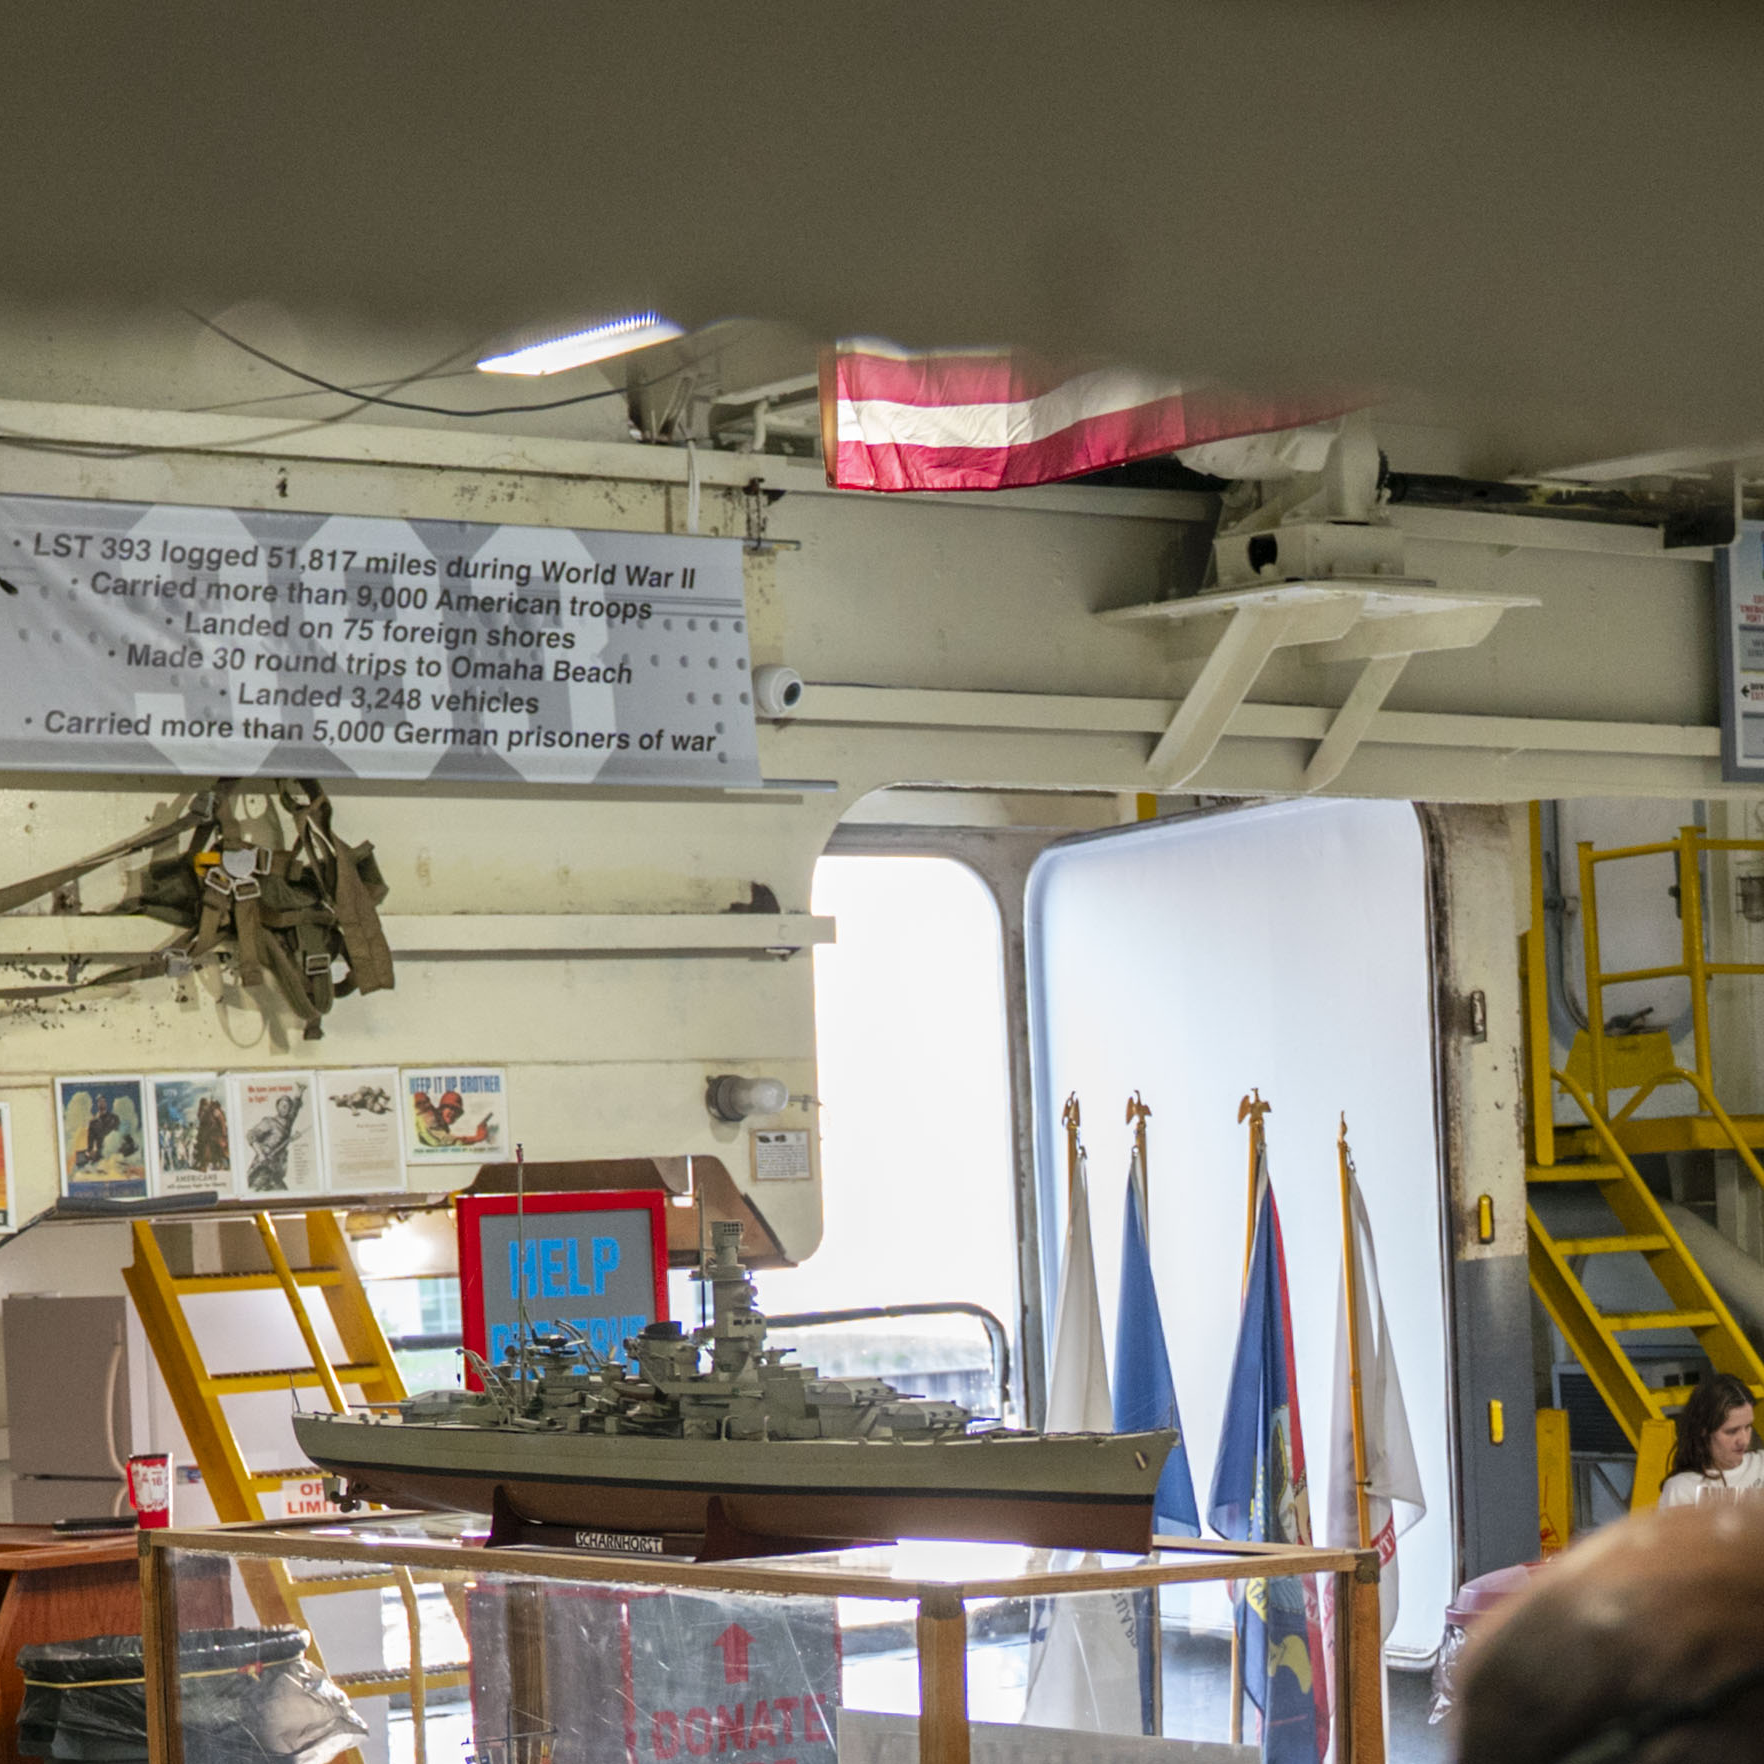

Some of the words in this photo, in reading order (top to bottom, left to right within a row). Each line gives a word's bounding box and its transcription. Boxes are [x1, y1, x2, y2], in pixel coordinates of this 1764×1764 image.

[34, 532, 93, 559] LST
[101, 537, 151, 562] 393
[161, 540, 258, 571] logged
[267, 547, 357, 575] 51,817
[365, 553, 436, 576] miles
[446, 556, 531, 587] during
[541, 560, 616, 586] World
[625, 565, 673, 588] War
[681, 567, 695, 589] II
[91, 571, 196, 599] Carried
[201, 581, 278, 602] more
[287, 581, 347, 606] than
[357, 585, 427, 612] 9,000
[436, 589, 560, 616] American
[570, 598, 652, 623] troops
[185, 611, 290, 638] Landed
[299, 620, 332, 640] on
[343, 618, 373, 641] 75
[383, 620, 477, 650] foreign
[486, 625, 576, 649] shores
[126, 643, 204, 669] Made
[212, 648, 245, 671] 30
[255, 651, 336, 674] round
[346, 653, 406, 680] trips
[416, 656, 441, 677] to
[450, 657, 543, 681] Omaha
[553, 660, 632, 684] Beach
[239, 683, 342, 708] Landed
[351, 687, 421, 712] 3,248
[431, 690, 539, 714] vehicles
[44, 710, 151, 736] Carried
[161, 718, 233, 739] more
[242, 718, 304, 742] than
[312, 720, 384, 745] 5,000
[393, 721, 498, 746] German
[507, 726, 630, 752] prisoners
[639, 728, 665, 750] of
[672, 732, 717, 752] war
[460, 1075, 501, 1093] BROTHER
[508, 1236, 620, 1300] HELP
[300, 1483, 324, 1496] OF
[577, 1532, 661, 1553] SCHARNHORST
[651, 1693, 827, 1760] DONATE
